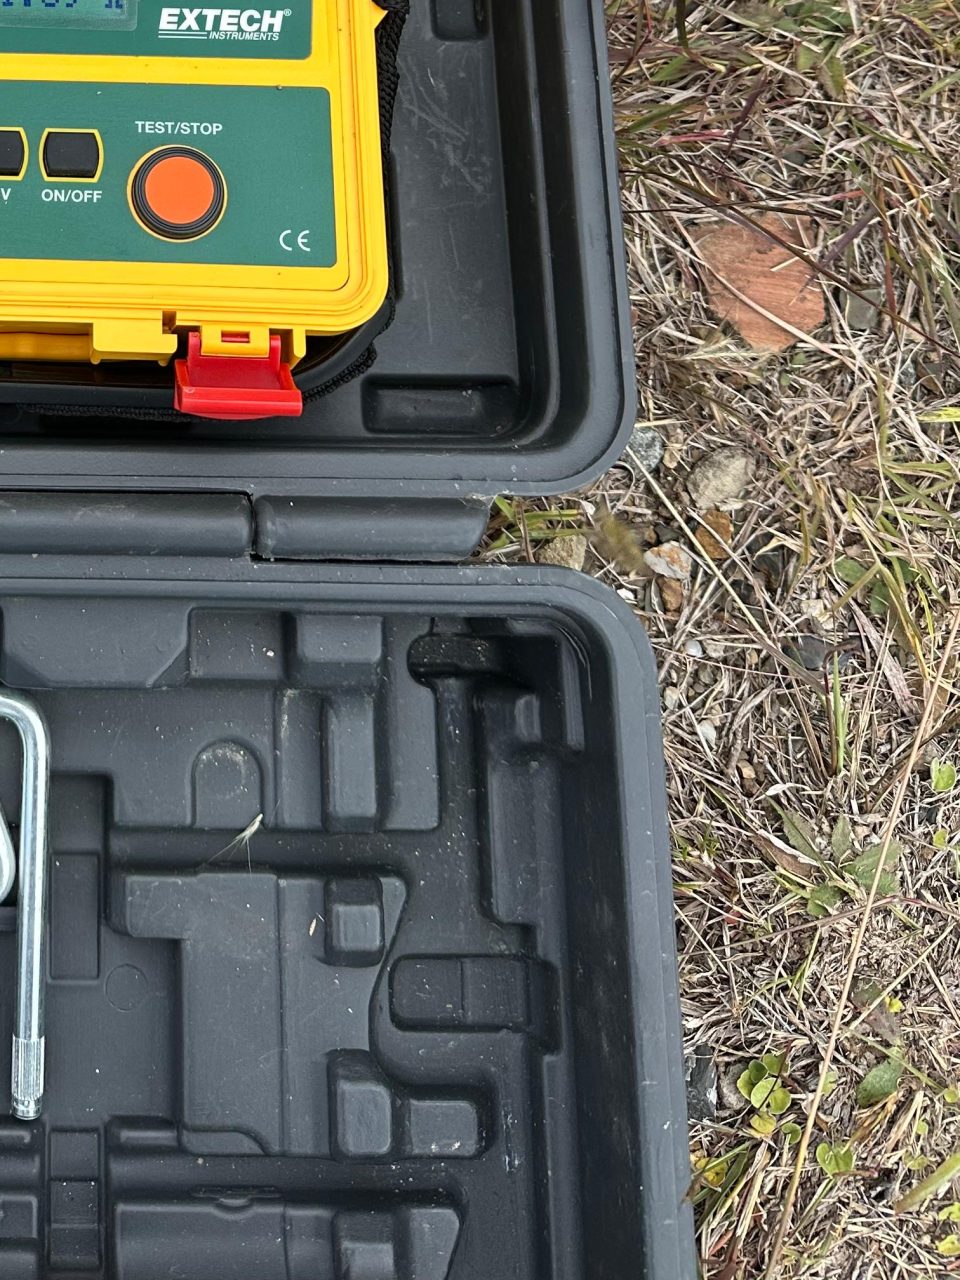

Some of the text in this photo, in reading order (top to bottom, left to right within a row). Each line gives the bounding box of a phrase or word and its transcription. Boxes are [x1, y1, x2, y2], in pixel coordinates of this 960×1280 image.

[209, 31, 280, 41] INSTRUMENTS
[134, 120, 223, 135] TEST/STOP
[41, 188, 102, 203] ON/OFF
